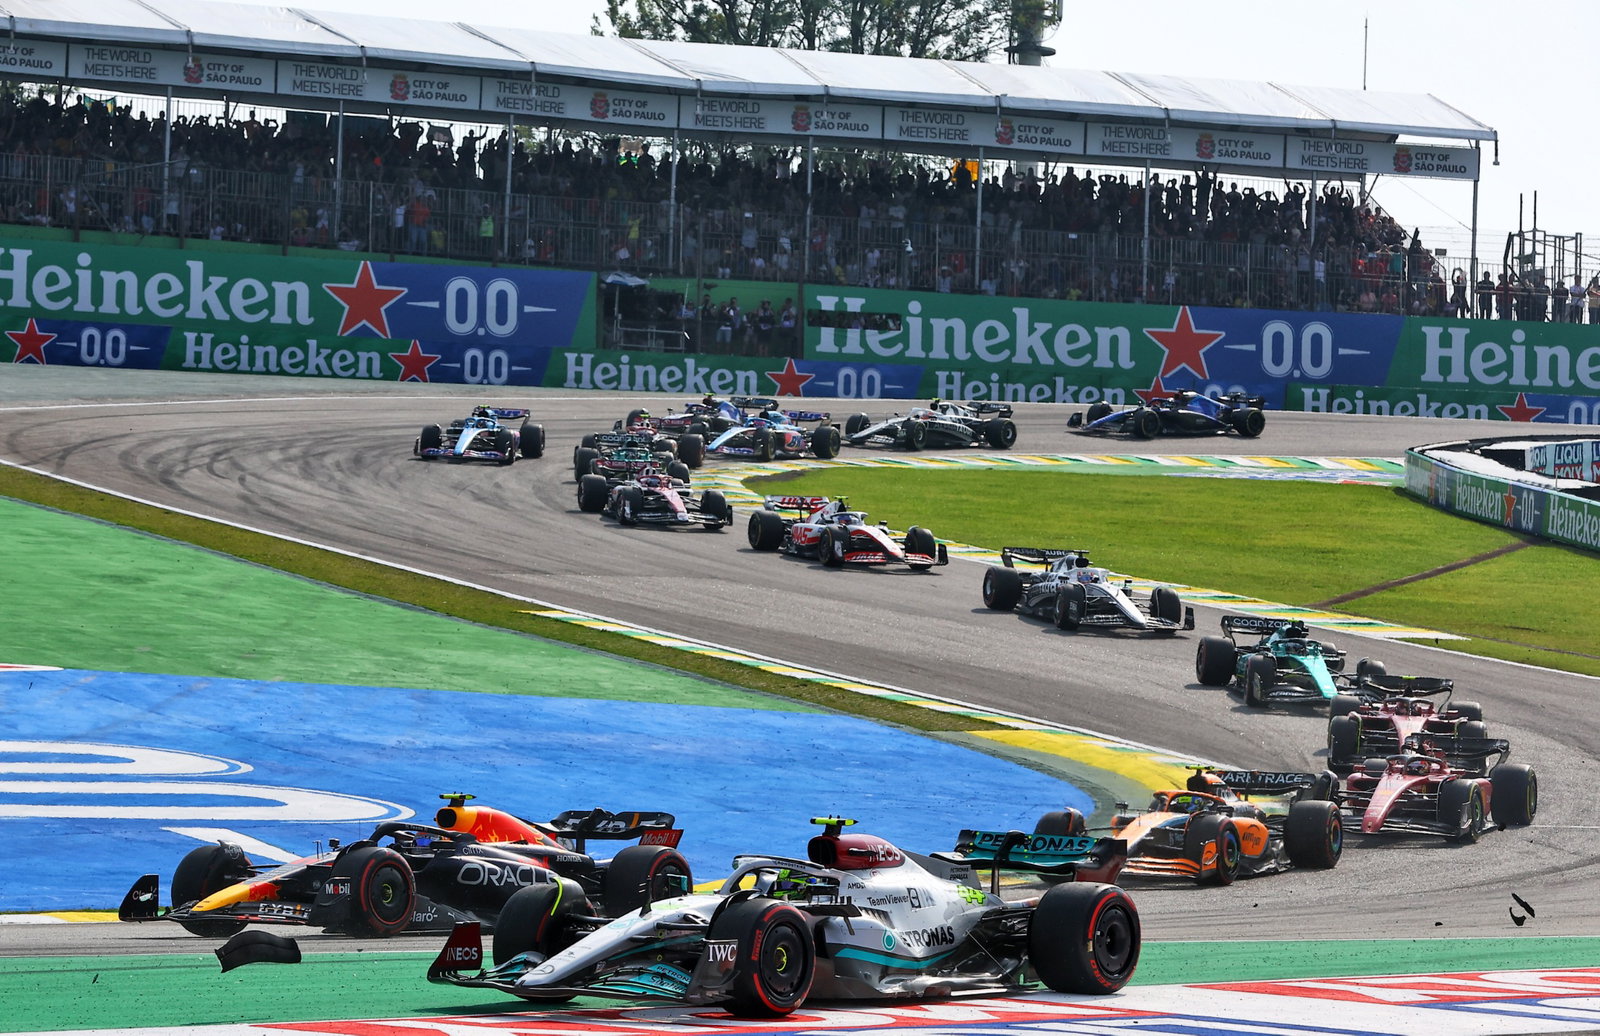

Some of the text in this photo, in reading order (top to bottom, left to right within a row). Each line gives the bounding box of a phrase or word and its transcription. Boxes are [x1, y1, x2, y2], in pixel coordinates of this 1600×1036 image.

[21, 47, 35, 56] OF
[109, 50, 151, 64] WORLD
[0, 55, 53, 69] ÃO PAULO
[206, 62, 245, 73] CITY OF
[84, 63, 156, 79] MEETS HERE
[316, 66, 359, 81] WORLD
[206, 72, 262, 86] SÃO PAULO
[412, 80, 450, 90] CITY OF
[292, 80, 364, 97] MEETS HERE
[412, 89, 467, 102] SÃO PAULO
[496, 97, 565, 113] MEETS HERE
[612, 98, 649, 108] CITY OF
[719, 101, 760, 114] WORLD
[612, 107, 666, 121] SÃO PAULO
[695, 114, 765, 129] MEETS HERE
[837, 111, 852, 121] OF
[923, 112, 965, 126] WORLD
[814, 120, 869, 132] SÃO PAULO
[899, 125, 969, 141] MEETS HERE
[1017, 124, 1055, 135] CITY OF
[1017, 134, 1072, 147] SÃO PAULO
[1125, 127, 1166, 141] WORLD
[1101, 140, 1171, 156] MEETS HERE
[1217, 139, 1255, 149] CITY OF
[1217, 148, 1271, 160] SÃO PAULO
[1414, 152, 1451, 162] CITY OF
[1301, 155, 1368, 170] MEETS HERE
[1414, 161, 1467, 174] SÃO PAULO
[0, 247, 315, 326] Heineken
[444, 275, 519, 338] 0.0
[815, 295, 1136, 370] Heineken
[80, 326, 127, 366] 0.0
[1260, 320, 1334, 379] 0.0
[182, 331, 384, 379] Heineken
[1421, 325, 1600, 390] Heine
[463, 347, 509, 385] 0.0
[562, 351, 760, 397] Heineken
[836, 366, 882, 399] 00
[935, 371, 1126, 405] Heineken
[1554, 445, 1583, 465] LIQUI
[1455, 473, 1502, 521] Heineken
[1548, 494, 1600, 548] Heineke
[640, 832, 668, 845] Mobil
[977, 832, 1090, 853] PERONAS
[867, 844, 901, 862] INEOS
[456, 862, 560, 886] ORACLE
[325, 882, 351, 895] Mobil
[866, 893, 909, 907] TeamViewer
[411, 910, 434, 922] laro
[446, 946, 479, 961] INEOS
[708, 943, 738, 962] IWC
[655, 965, 691, 982] PETRON
